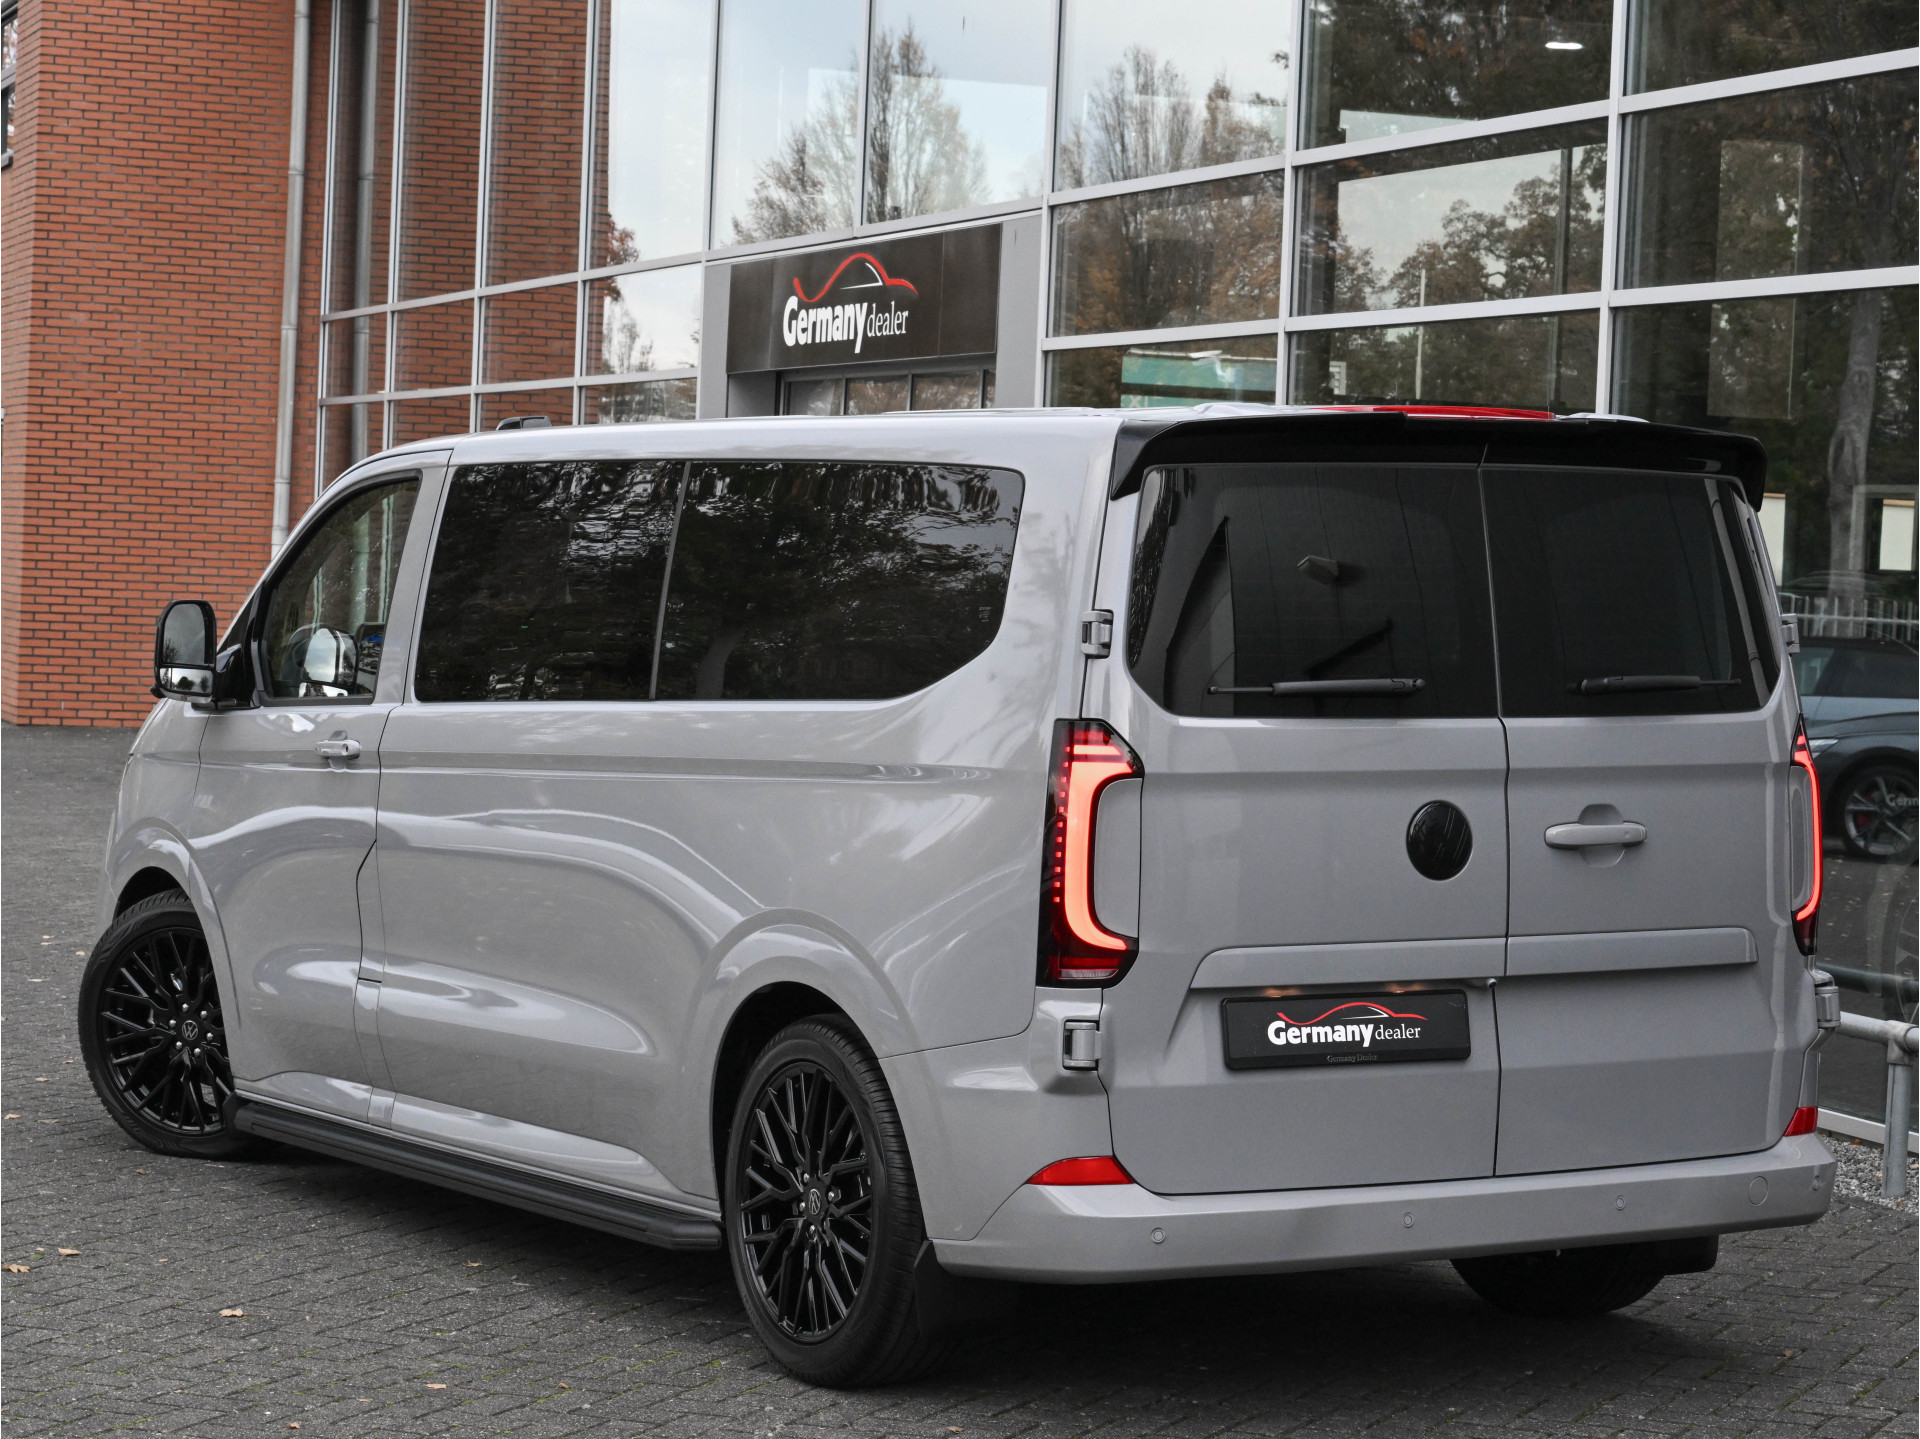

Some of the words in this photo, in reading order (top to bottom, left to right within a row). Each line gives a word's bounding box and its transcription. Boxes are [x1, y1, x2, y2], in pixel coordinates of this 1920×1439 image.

[783, 295, 868, 354] Germany
[866, 300, 909, 337] dealer
[1267, 1020, 1374, 1047] Germany
[1375, 1023, 1421, 1041] dealer
